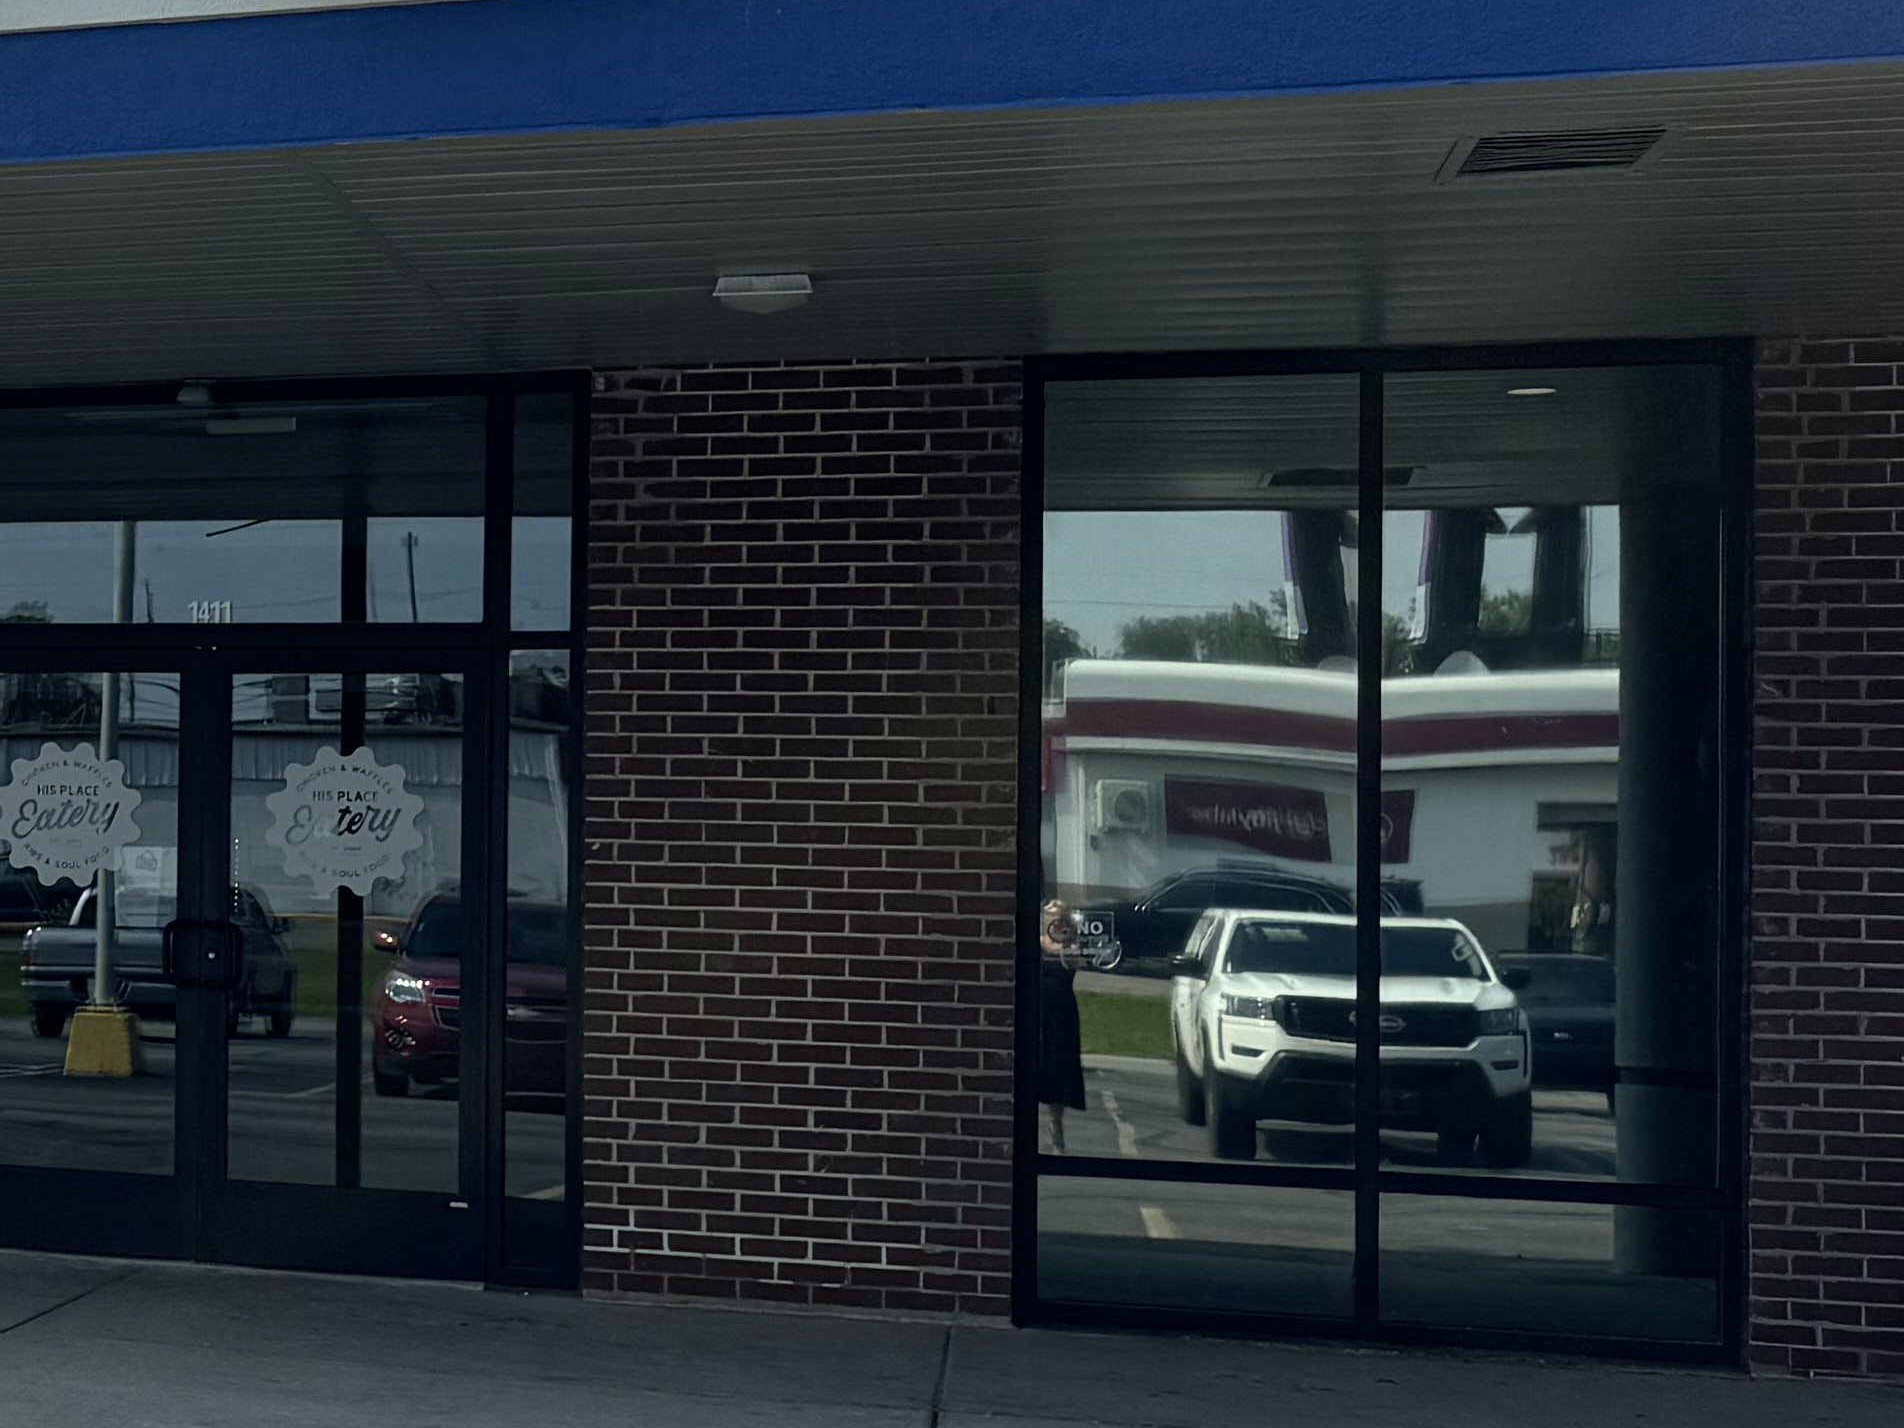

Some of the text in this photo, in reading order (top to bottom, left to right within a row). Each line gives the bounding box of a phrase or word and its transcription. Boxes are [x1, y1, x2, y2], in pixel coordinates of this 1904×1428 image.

[188, 601, 231, 624] 1411
[37, 784, 100, 796] HIS PLACE
[312, 790, 380, 802] HIS PLACE
[11, 798, 120, 839] Eatery
[285, 804, 402, 846] Eatery
[55, 860, 81, 869] SOUL
[1077, 921, 1103, 935] NO
